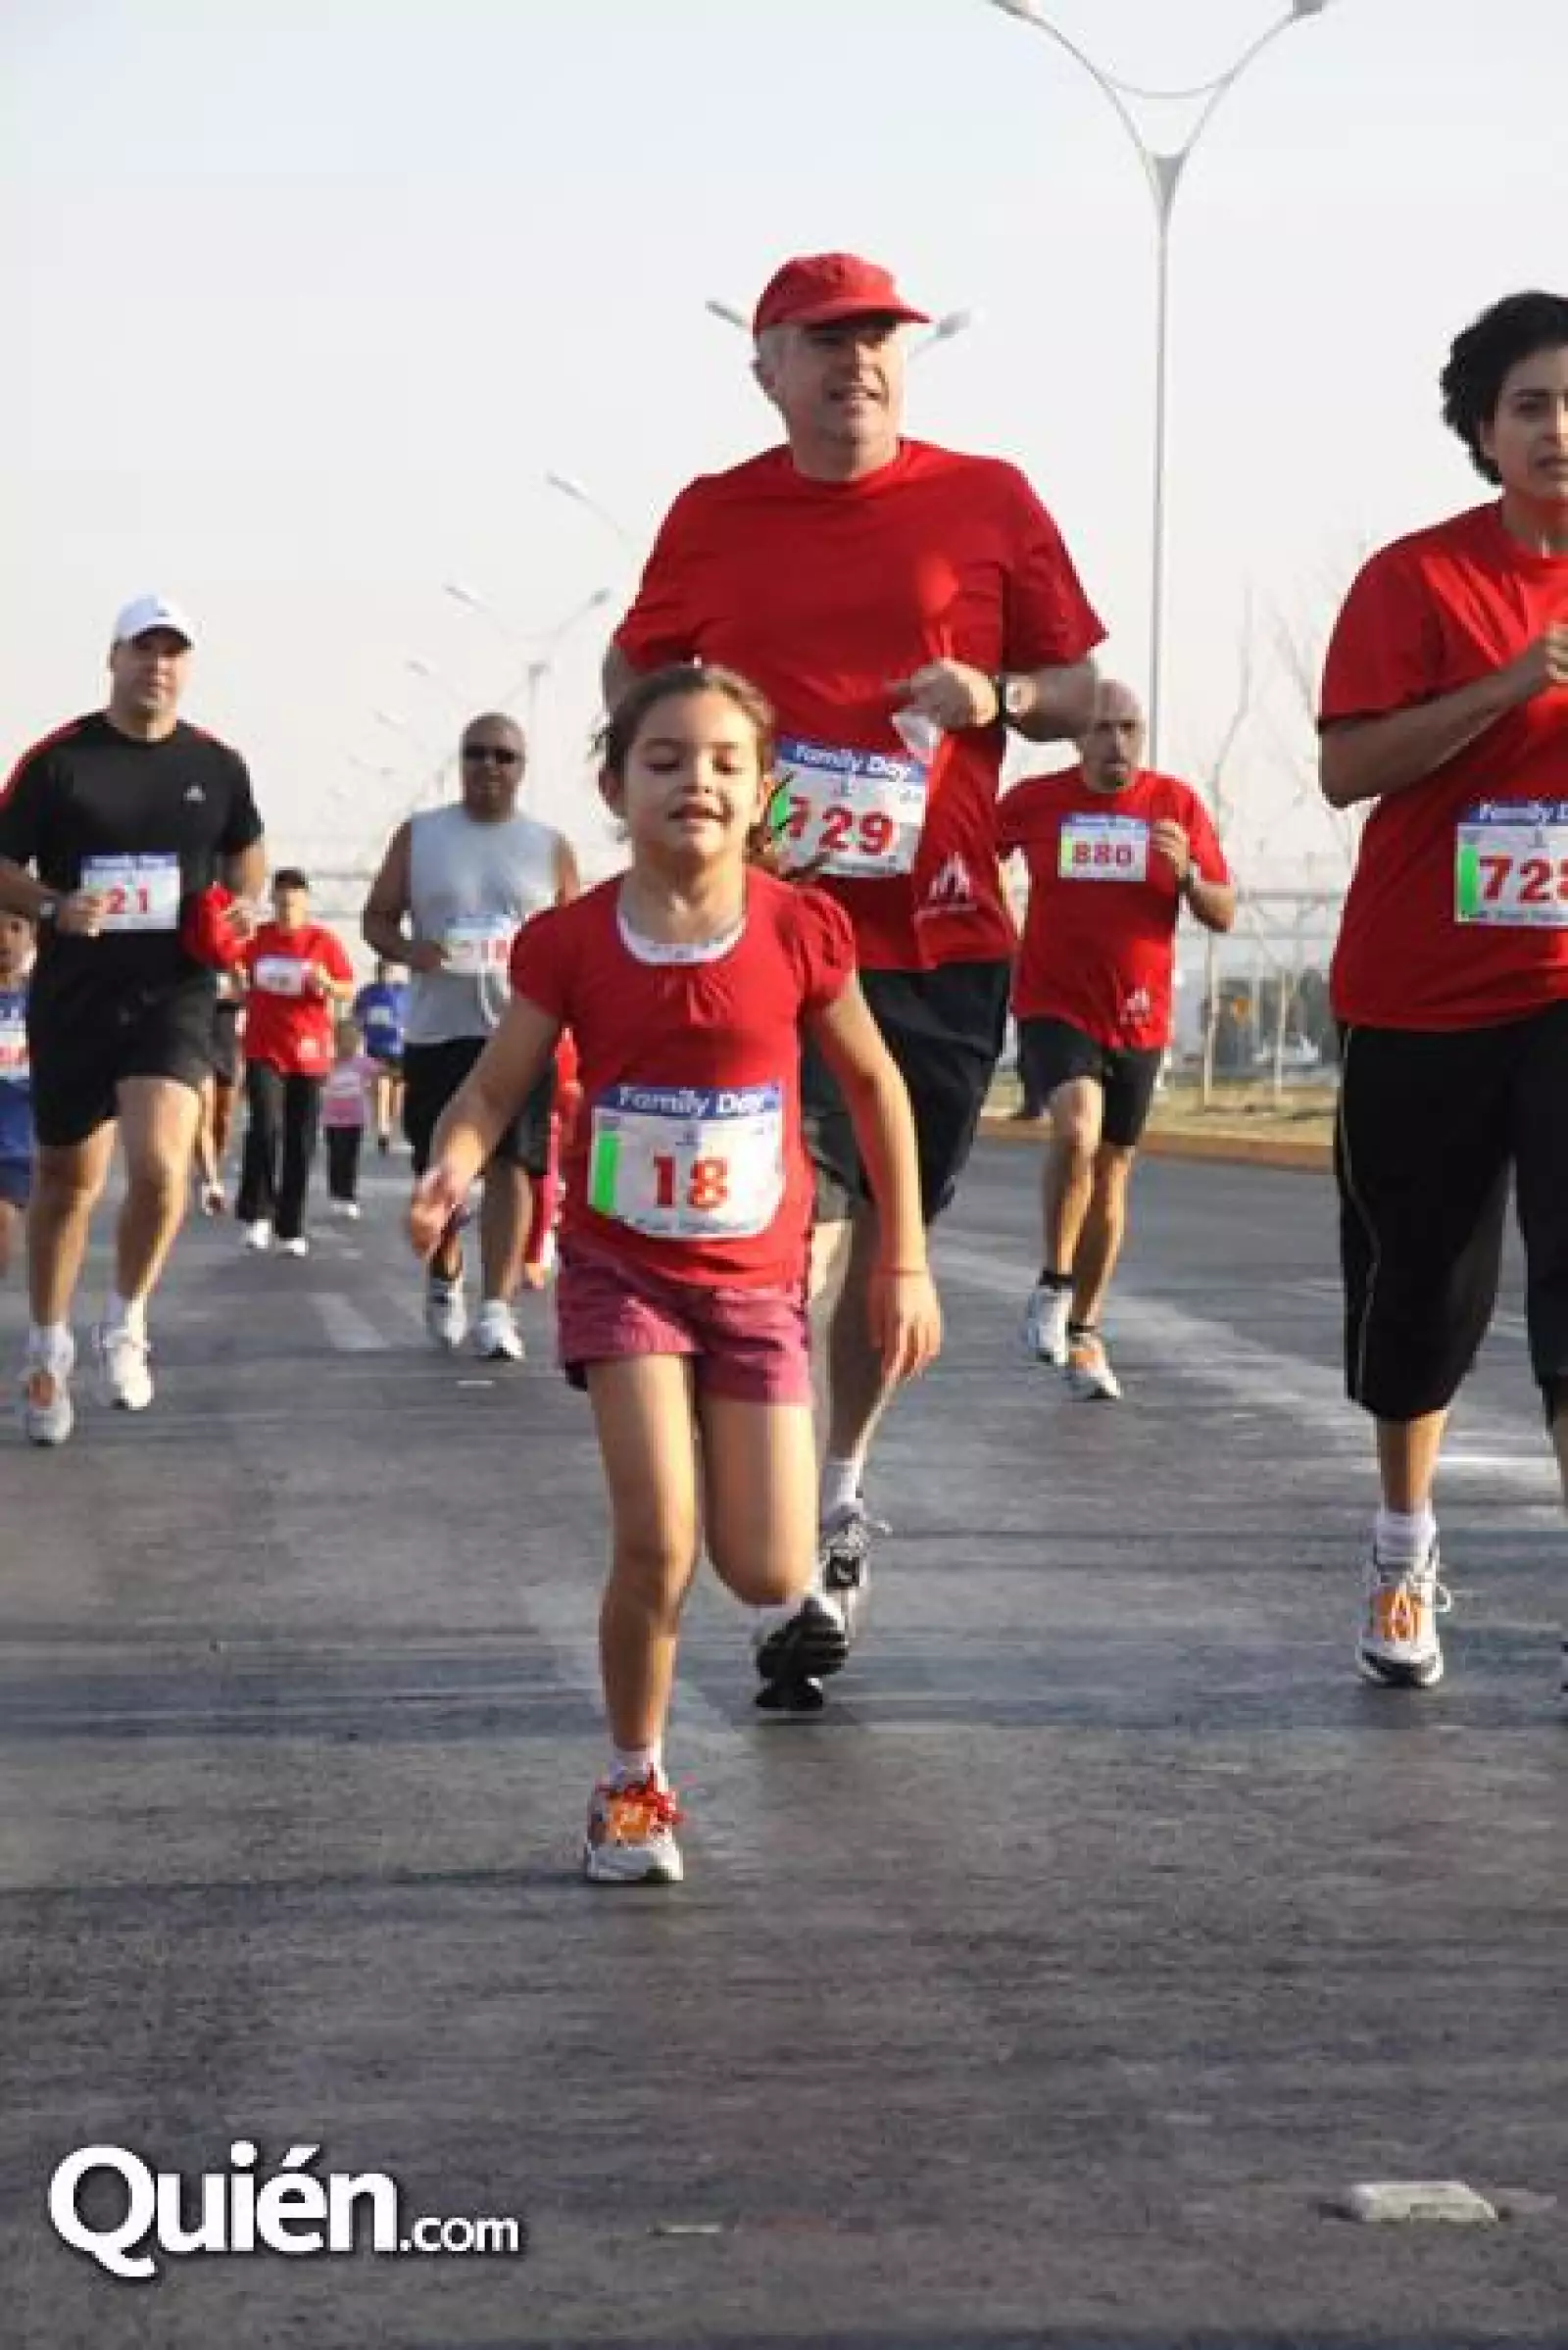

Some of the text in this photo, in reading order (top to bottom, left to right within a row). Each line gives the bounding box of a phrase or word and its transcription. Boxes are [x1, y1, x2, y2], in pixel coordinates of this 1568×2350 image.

[795, 741, 863, 773] Family
[787, 795, 894, 857] 729
[619, 1084, 710, 1117] Family
[653, 1154, 728, 1209] 18
